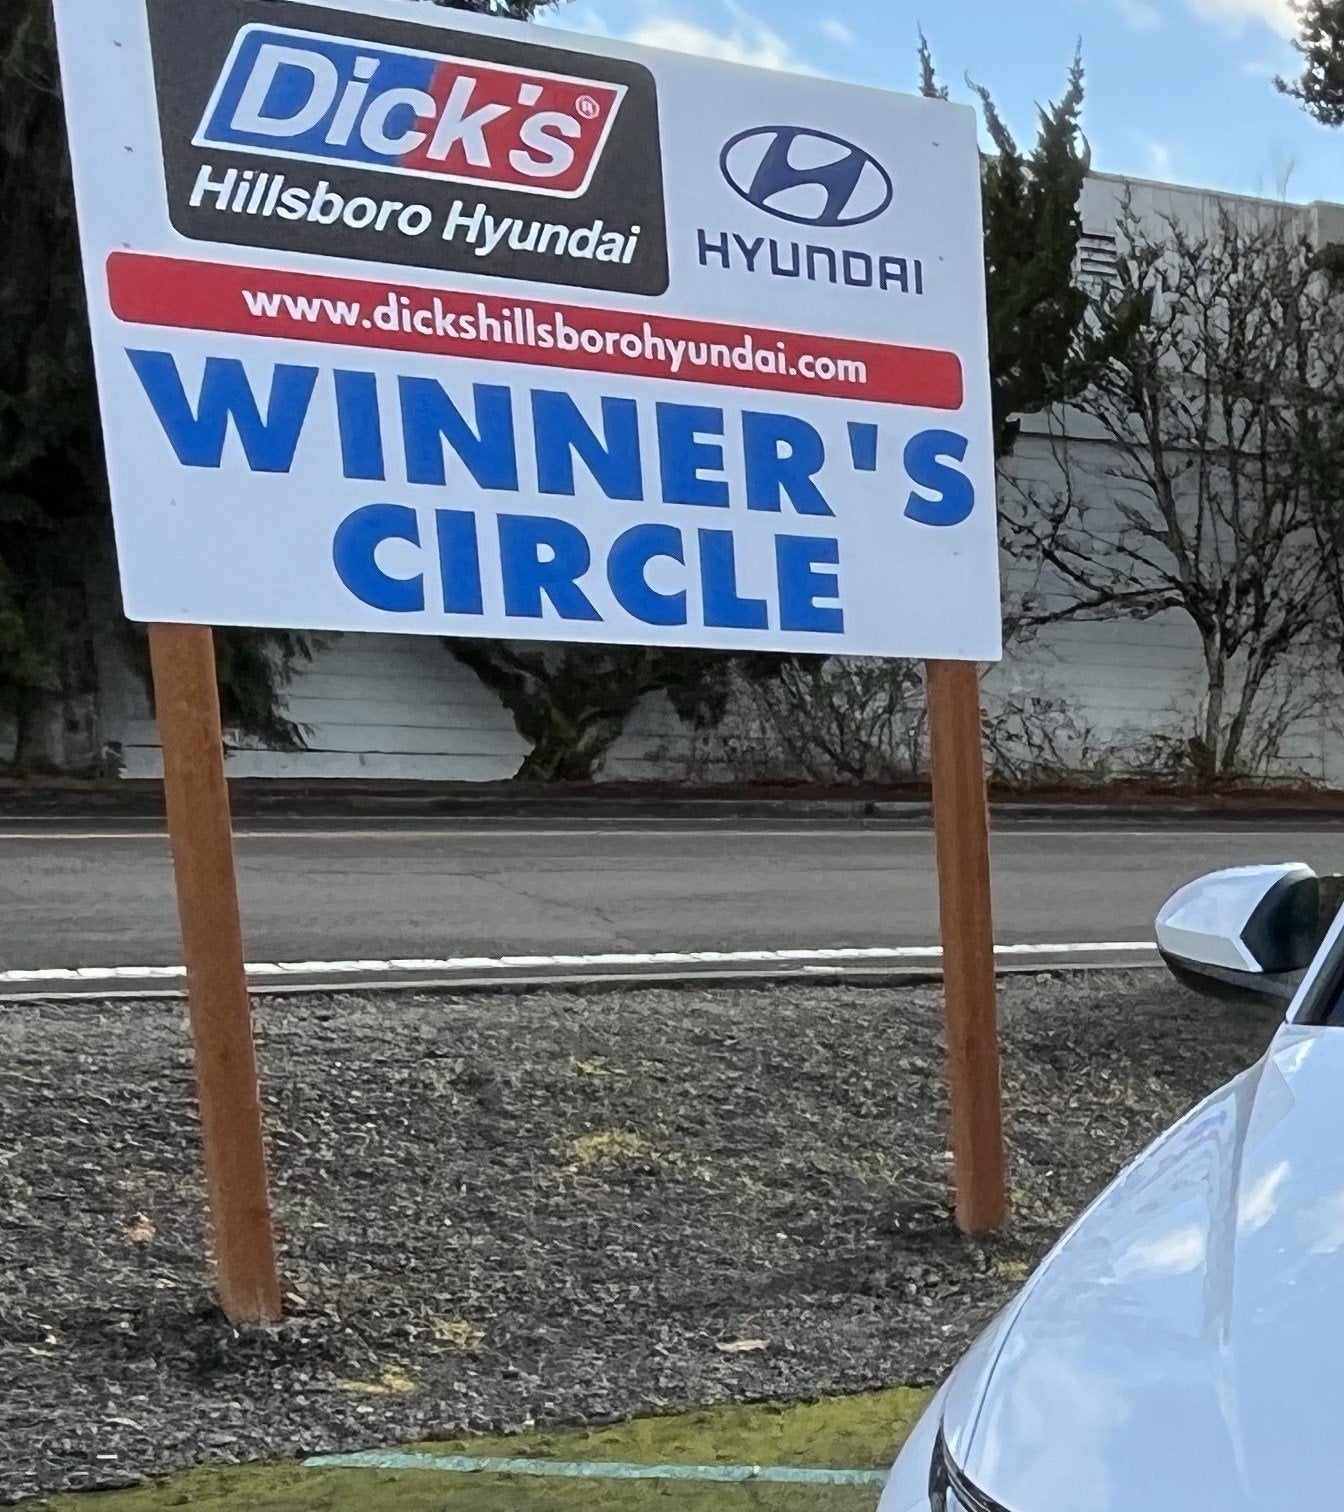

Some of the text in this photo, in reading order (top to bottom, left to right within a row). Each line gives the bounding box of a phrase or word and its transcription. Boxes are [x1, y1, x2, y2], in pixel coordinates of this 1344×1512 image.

[231, 43, 581, 178] Dick's
[188, 165, 642, 265] Hillsboro Hyundai
[697, 229, 923, 295] HYUNDAI
[242, 285, 867, 384] www.dickshillsborohyundai.com
[123, 348, 975, 526] WINNER'S
[332, 503, 845, 634] CIRCLE
